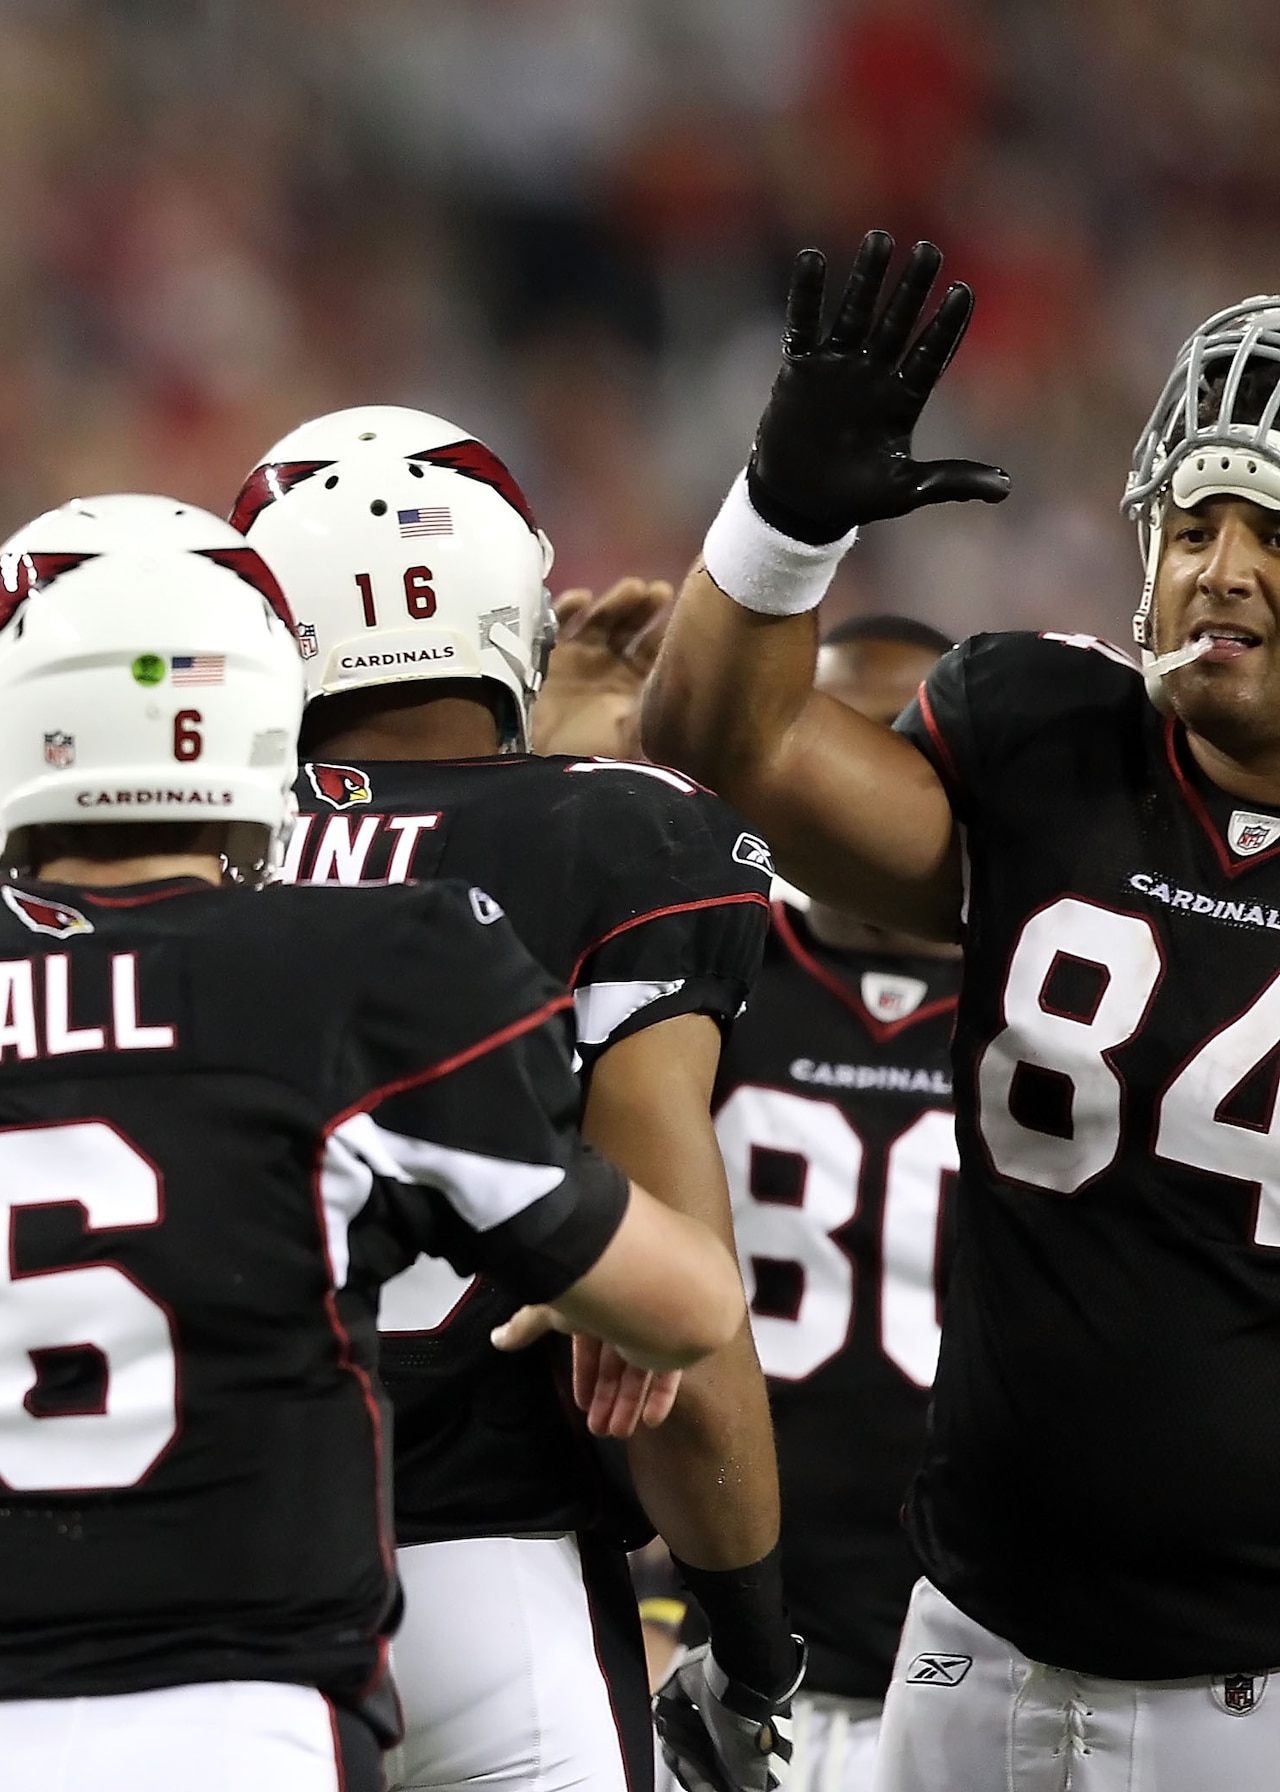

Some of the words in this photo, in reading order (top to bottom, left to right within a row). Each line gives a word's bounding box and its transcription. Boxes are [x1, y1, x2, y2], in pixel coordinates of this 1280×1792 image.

[354, 565, 438, 628] 16
[341, 646, 455, 669] CARDINALS
[173, 709, 203, 762] 6
[76, 788, 234, 808] CARDINALS
[976, 891, 1280, 1254] 84
